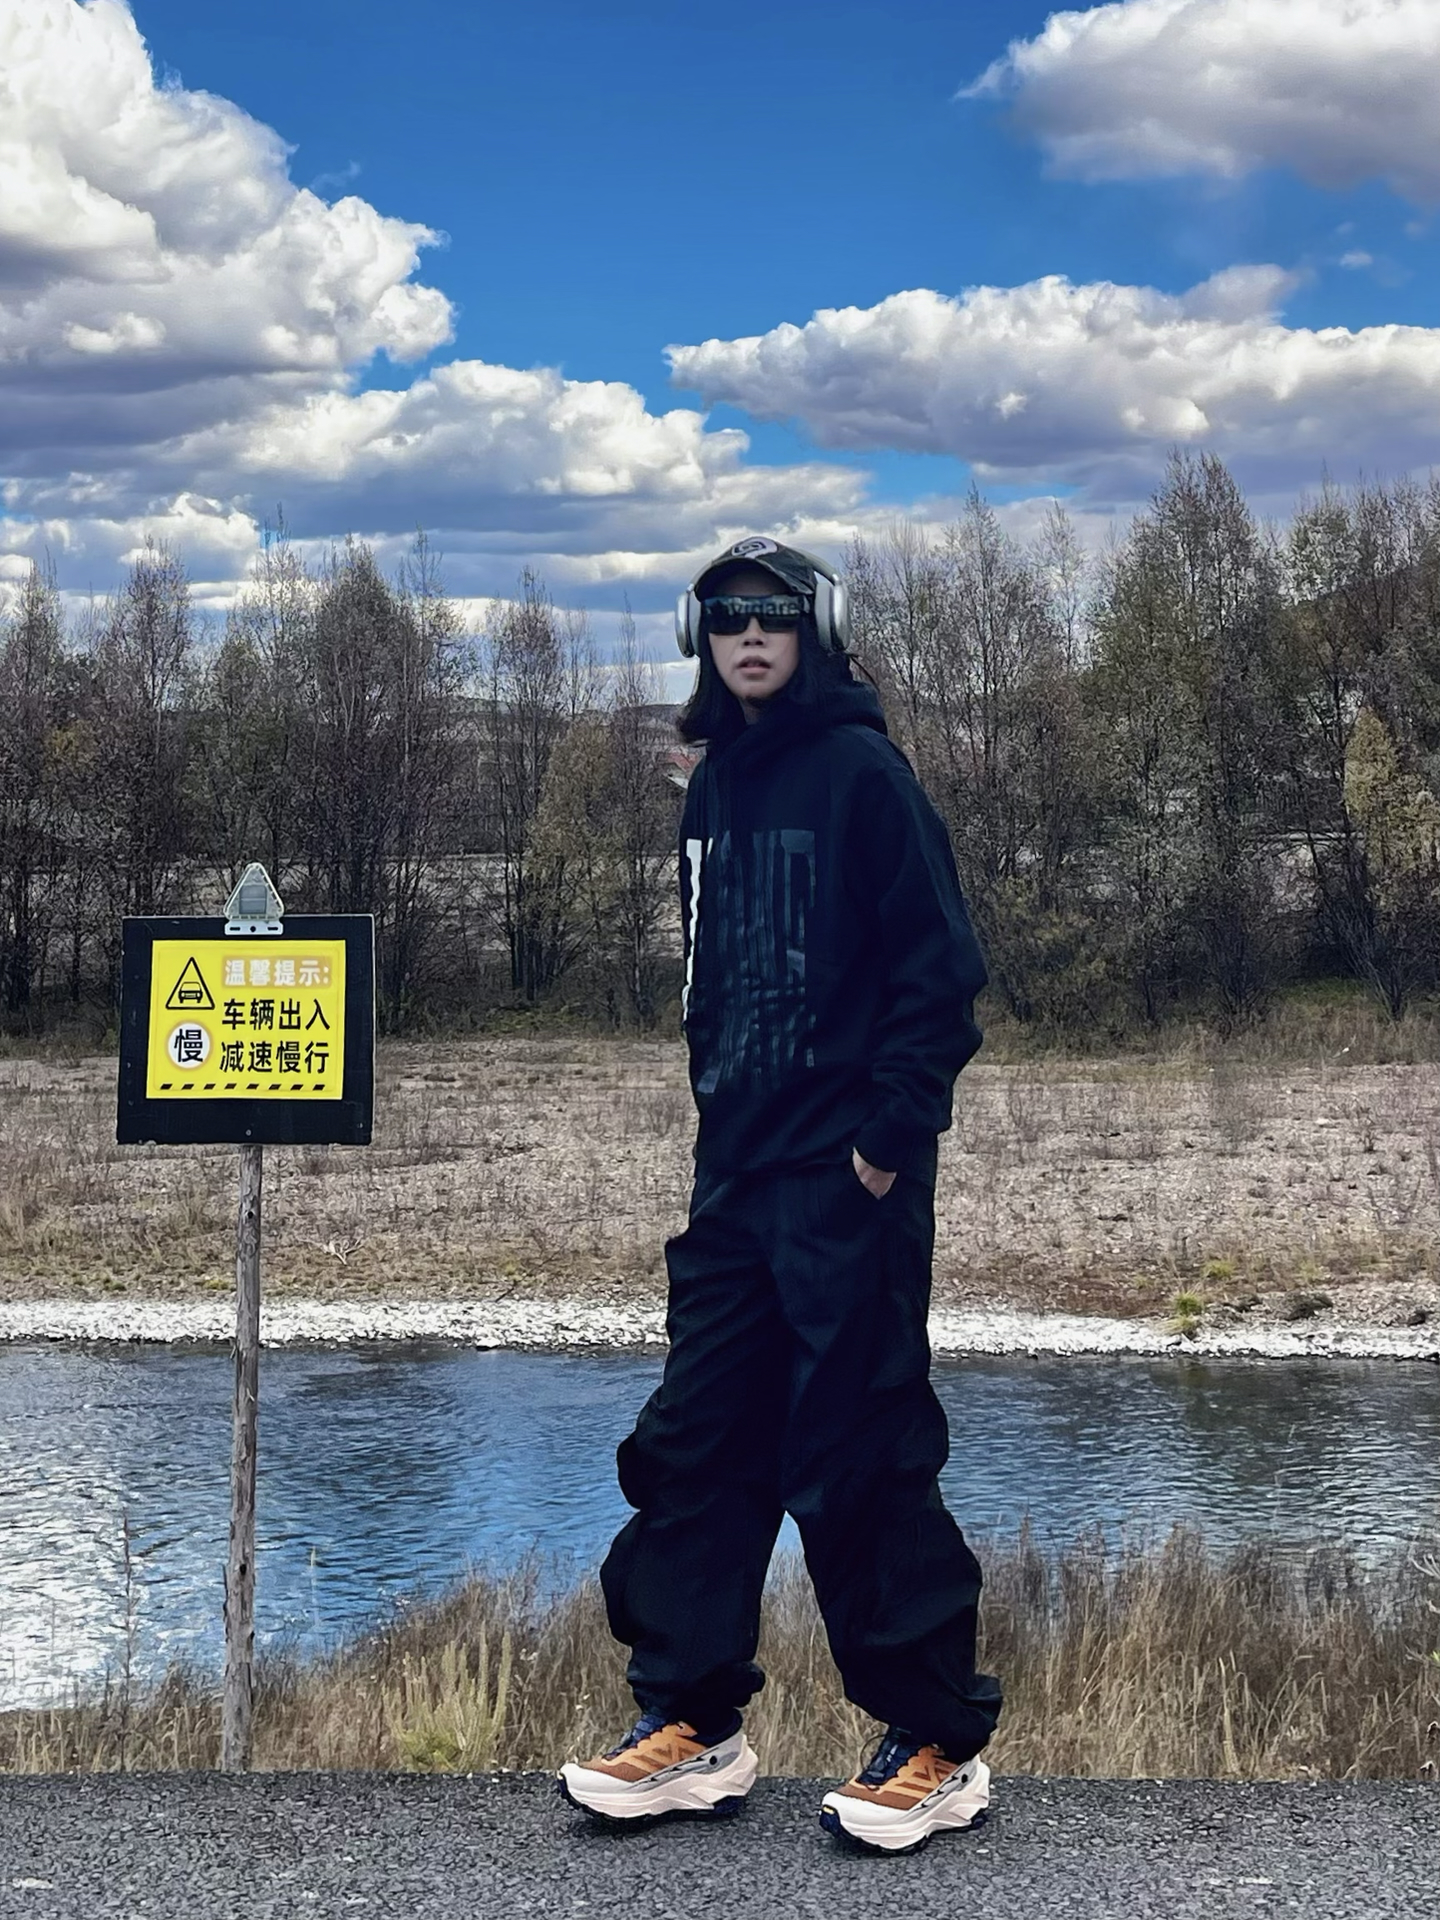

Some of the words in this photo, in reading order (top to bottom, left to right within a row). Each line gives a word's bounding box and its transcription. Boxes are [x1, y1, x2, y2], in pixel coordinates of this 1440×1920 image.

[222, 998, 331, 1031] 车辆出入
[174, 1028, 204, 1063] 慢
[219, 1040, 330, 1074] 减速慢行
